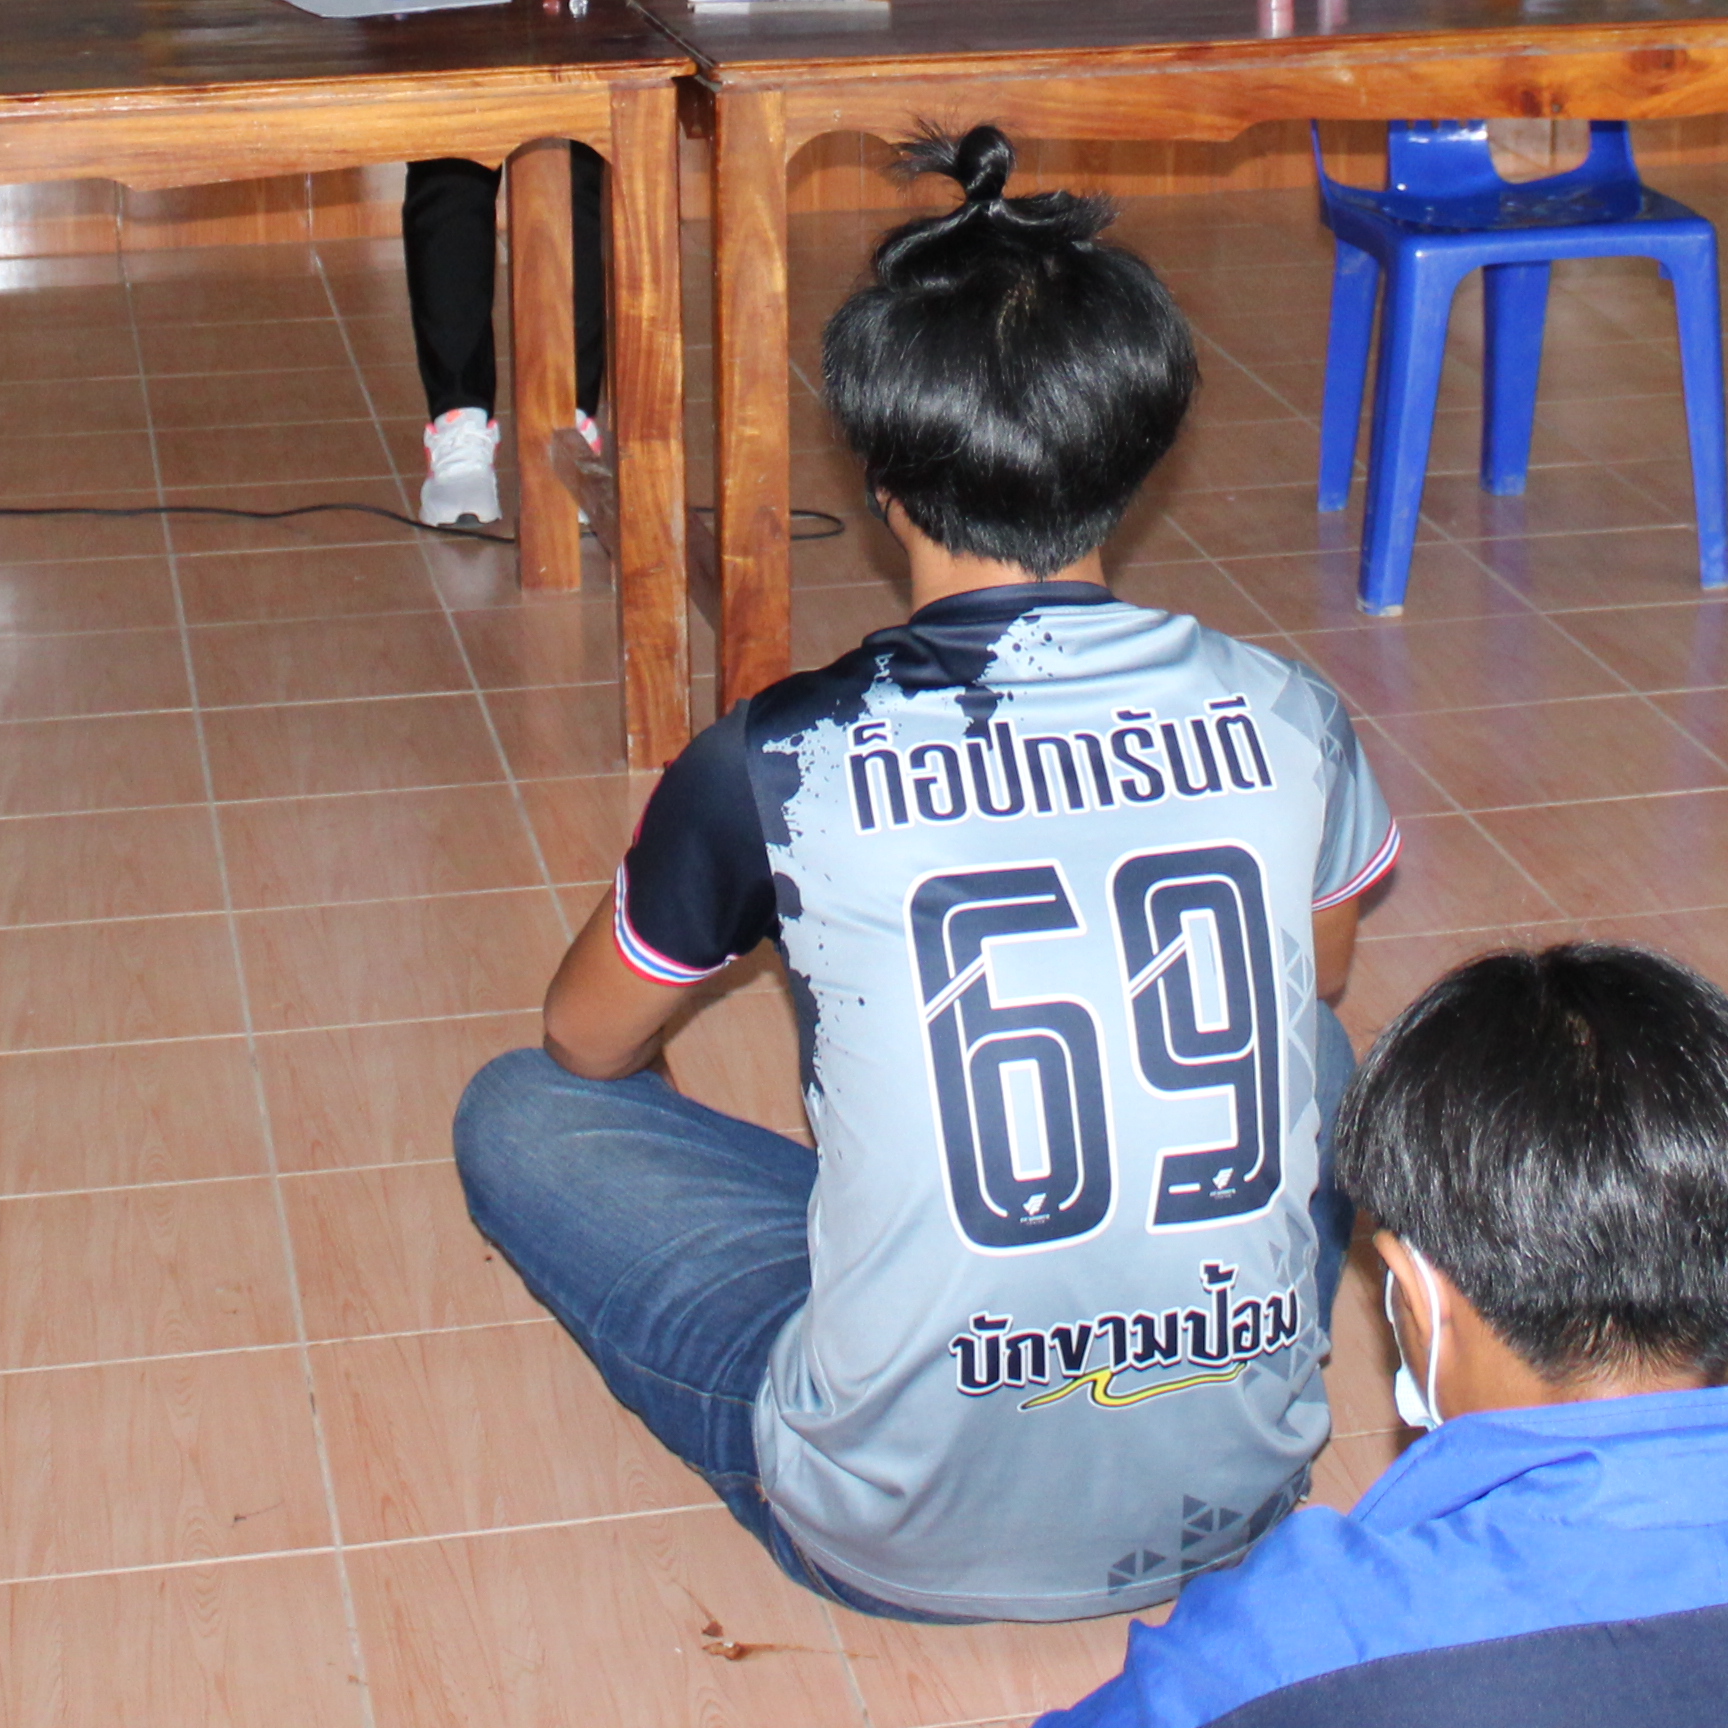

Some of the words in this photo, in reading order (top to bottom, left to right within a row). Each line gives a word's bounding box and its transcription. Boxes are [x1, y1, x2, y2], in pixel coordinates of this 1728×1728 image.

[903, 839, 1284, 1256] 69
[948, 1259, 1301, 1396] บักขามป้อม
